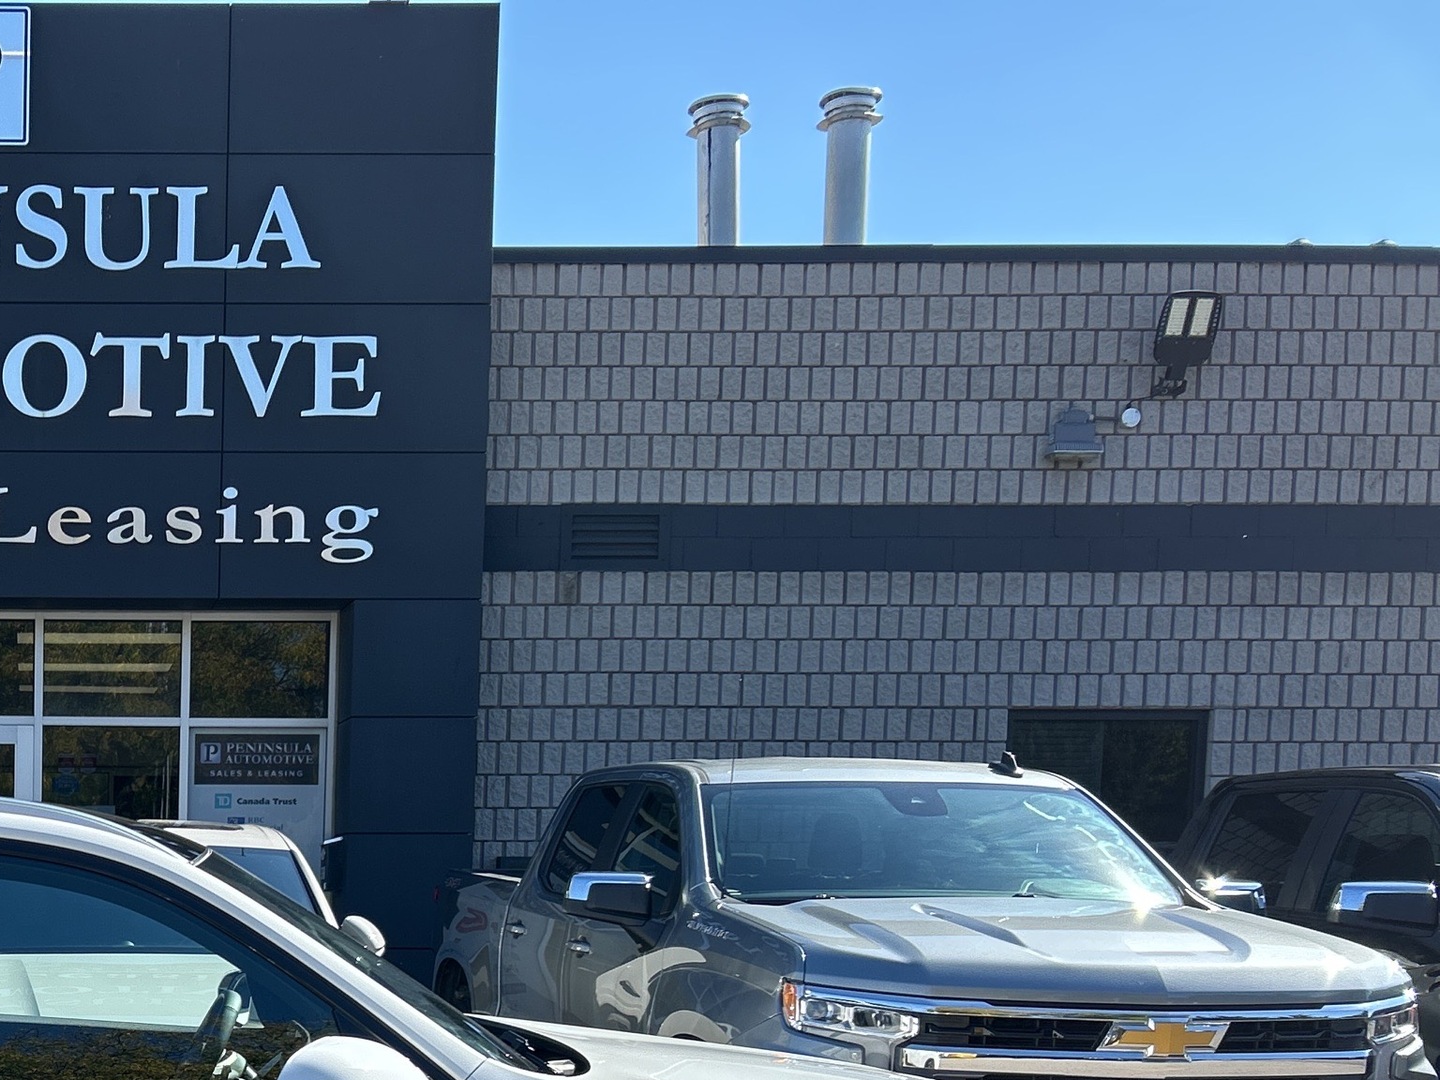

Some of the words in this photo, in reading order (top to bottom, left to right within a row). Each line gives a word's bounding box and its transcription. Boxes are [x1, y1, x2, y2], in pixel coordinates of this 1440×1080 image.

[225, 742, 313, 754] PENINSULA
[224, 754, 315, 765] AUTOMOTIVE
[209, 769, 243, 778] SALES
[246, 769, 253, 777] &
[257, 769, 304, 778] LEASING
[236, 797, 271, 806] Canada
[271, 797, 298, 806] Trust
